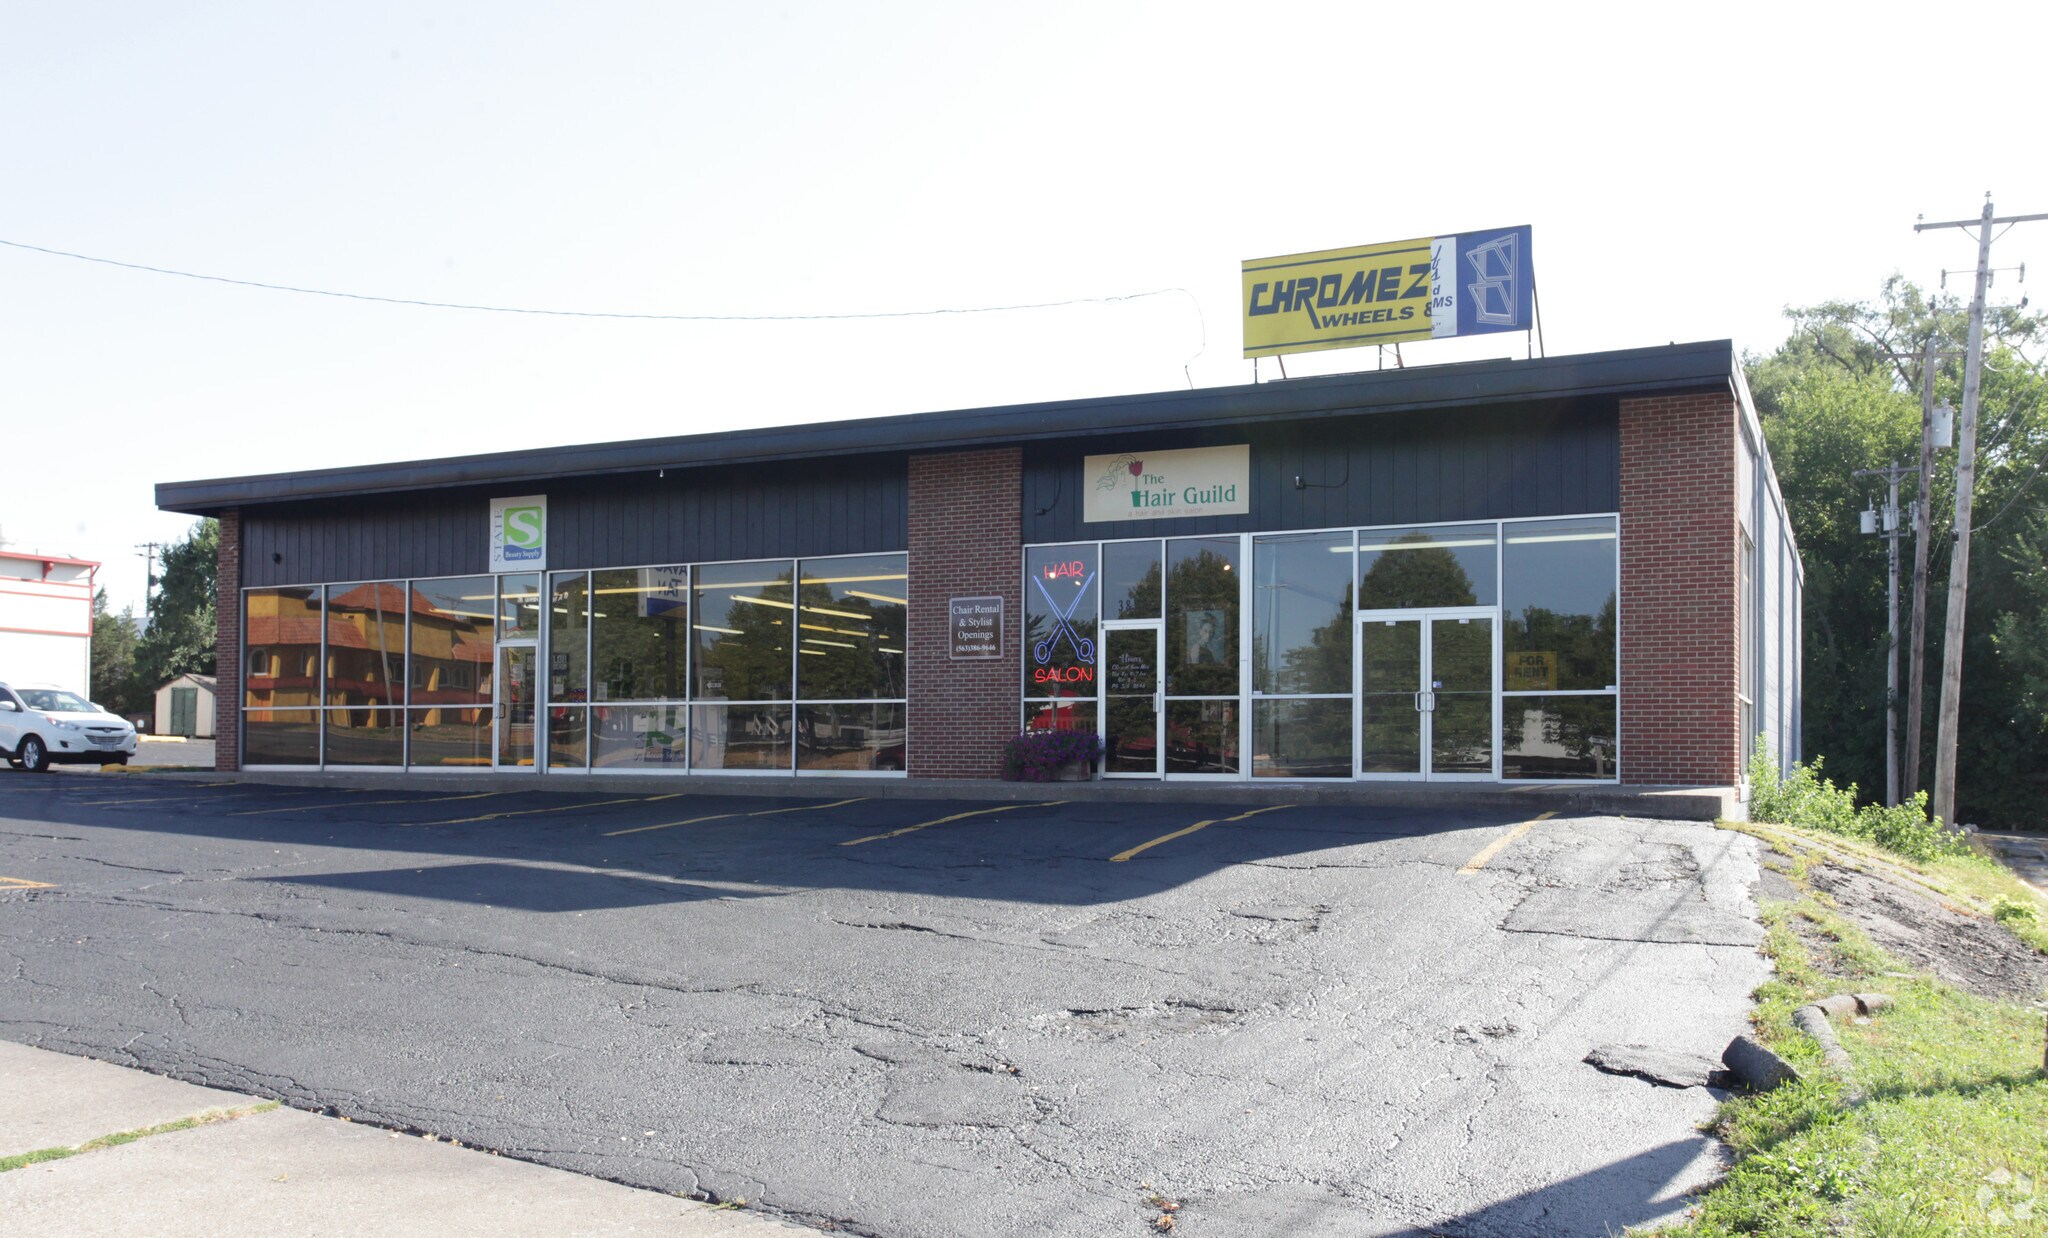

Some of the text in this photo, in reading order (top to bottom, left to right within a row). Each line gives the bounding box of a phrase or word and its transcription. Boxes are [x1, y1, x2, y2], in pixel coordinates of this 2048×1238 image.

[1248, 263, 1431, 329] CHROMEZ
[1321, 306, 1415, 328] WHEELS
[1143, 474, 1164, 485] The
[1131, 484, 1236, 507] Hair Guild
[494, 509, 503, 562] STATE
[505, 549, 540, 559] Beauty Supply
[1044, 560, 1084, 579] HAIR
[952, 604, 1000, 615] Chair Rental
[959, 617, 993, 628] & Stylist
[957, 630, 994, 641] Openings
[1519, 655, 1544, 666] FOR
[1035, 666, 1093, 683] SALON
[1515, 666, 1549, 678] RENT
